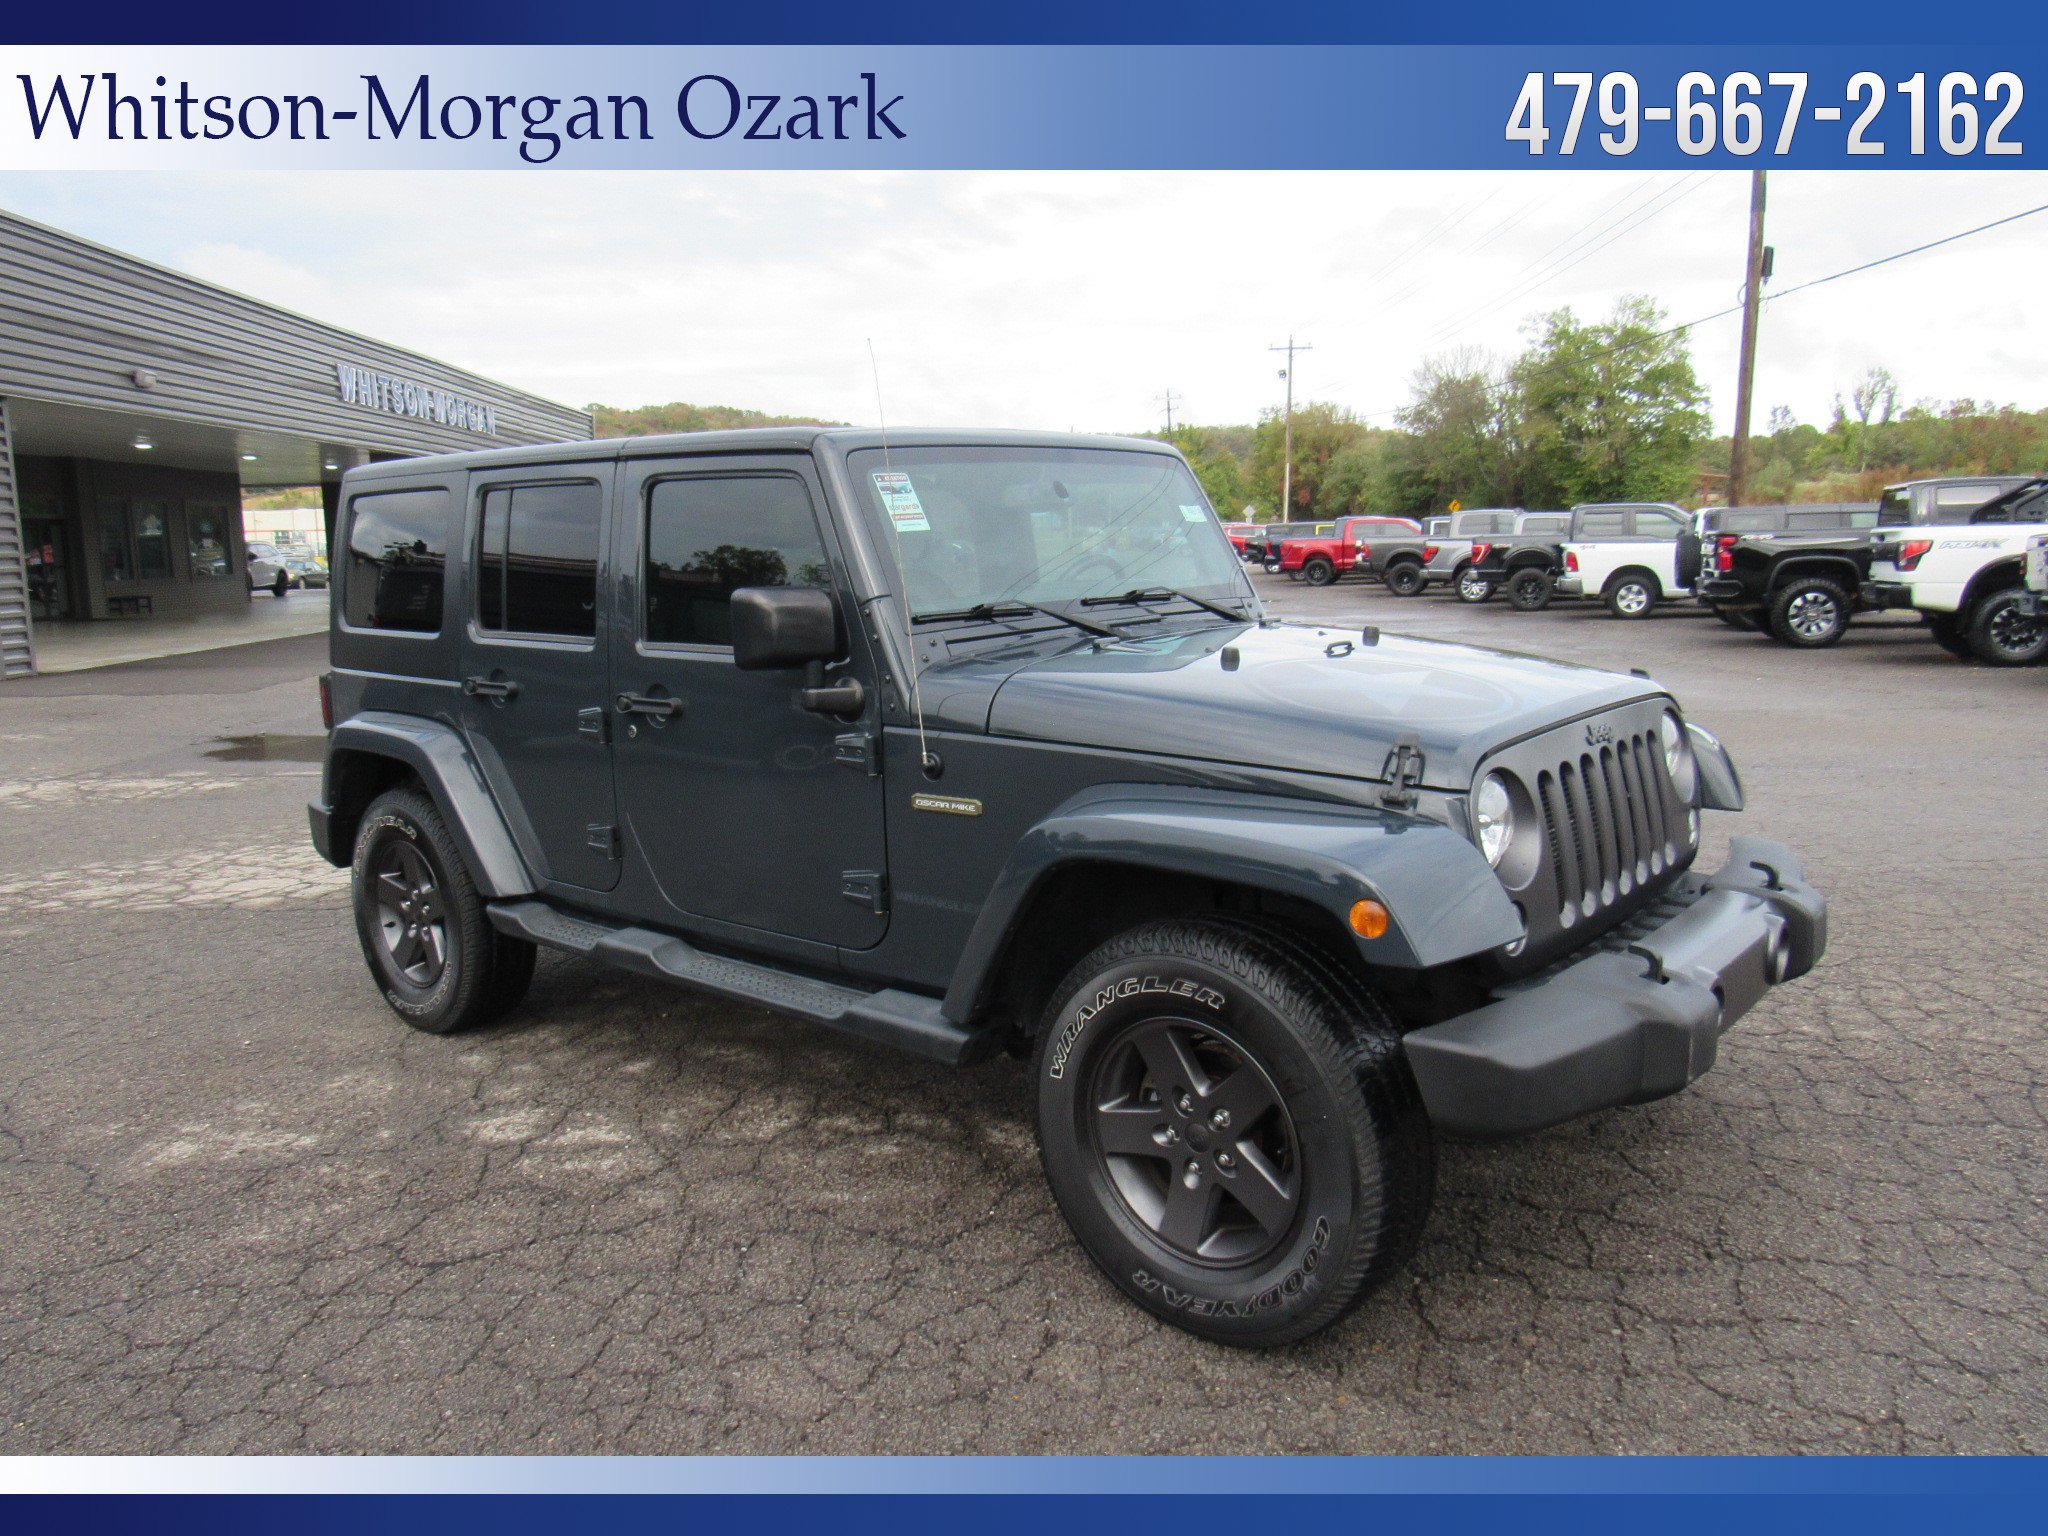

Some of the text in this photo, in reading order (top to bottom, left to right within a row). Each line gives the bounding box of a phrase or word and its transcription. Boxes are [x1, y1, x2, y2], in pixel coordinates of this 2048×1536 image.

[336, 363, 496, 436] WHITSON-MORGAN
[915, 799, 976, 812] OSCAR MIKE
[1050, 976, 1225, 1079] WRANGLER
[1132, 1215, 1331, 1318] GOODYEAR
